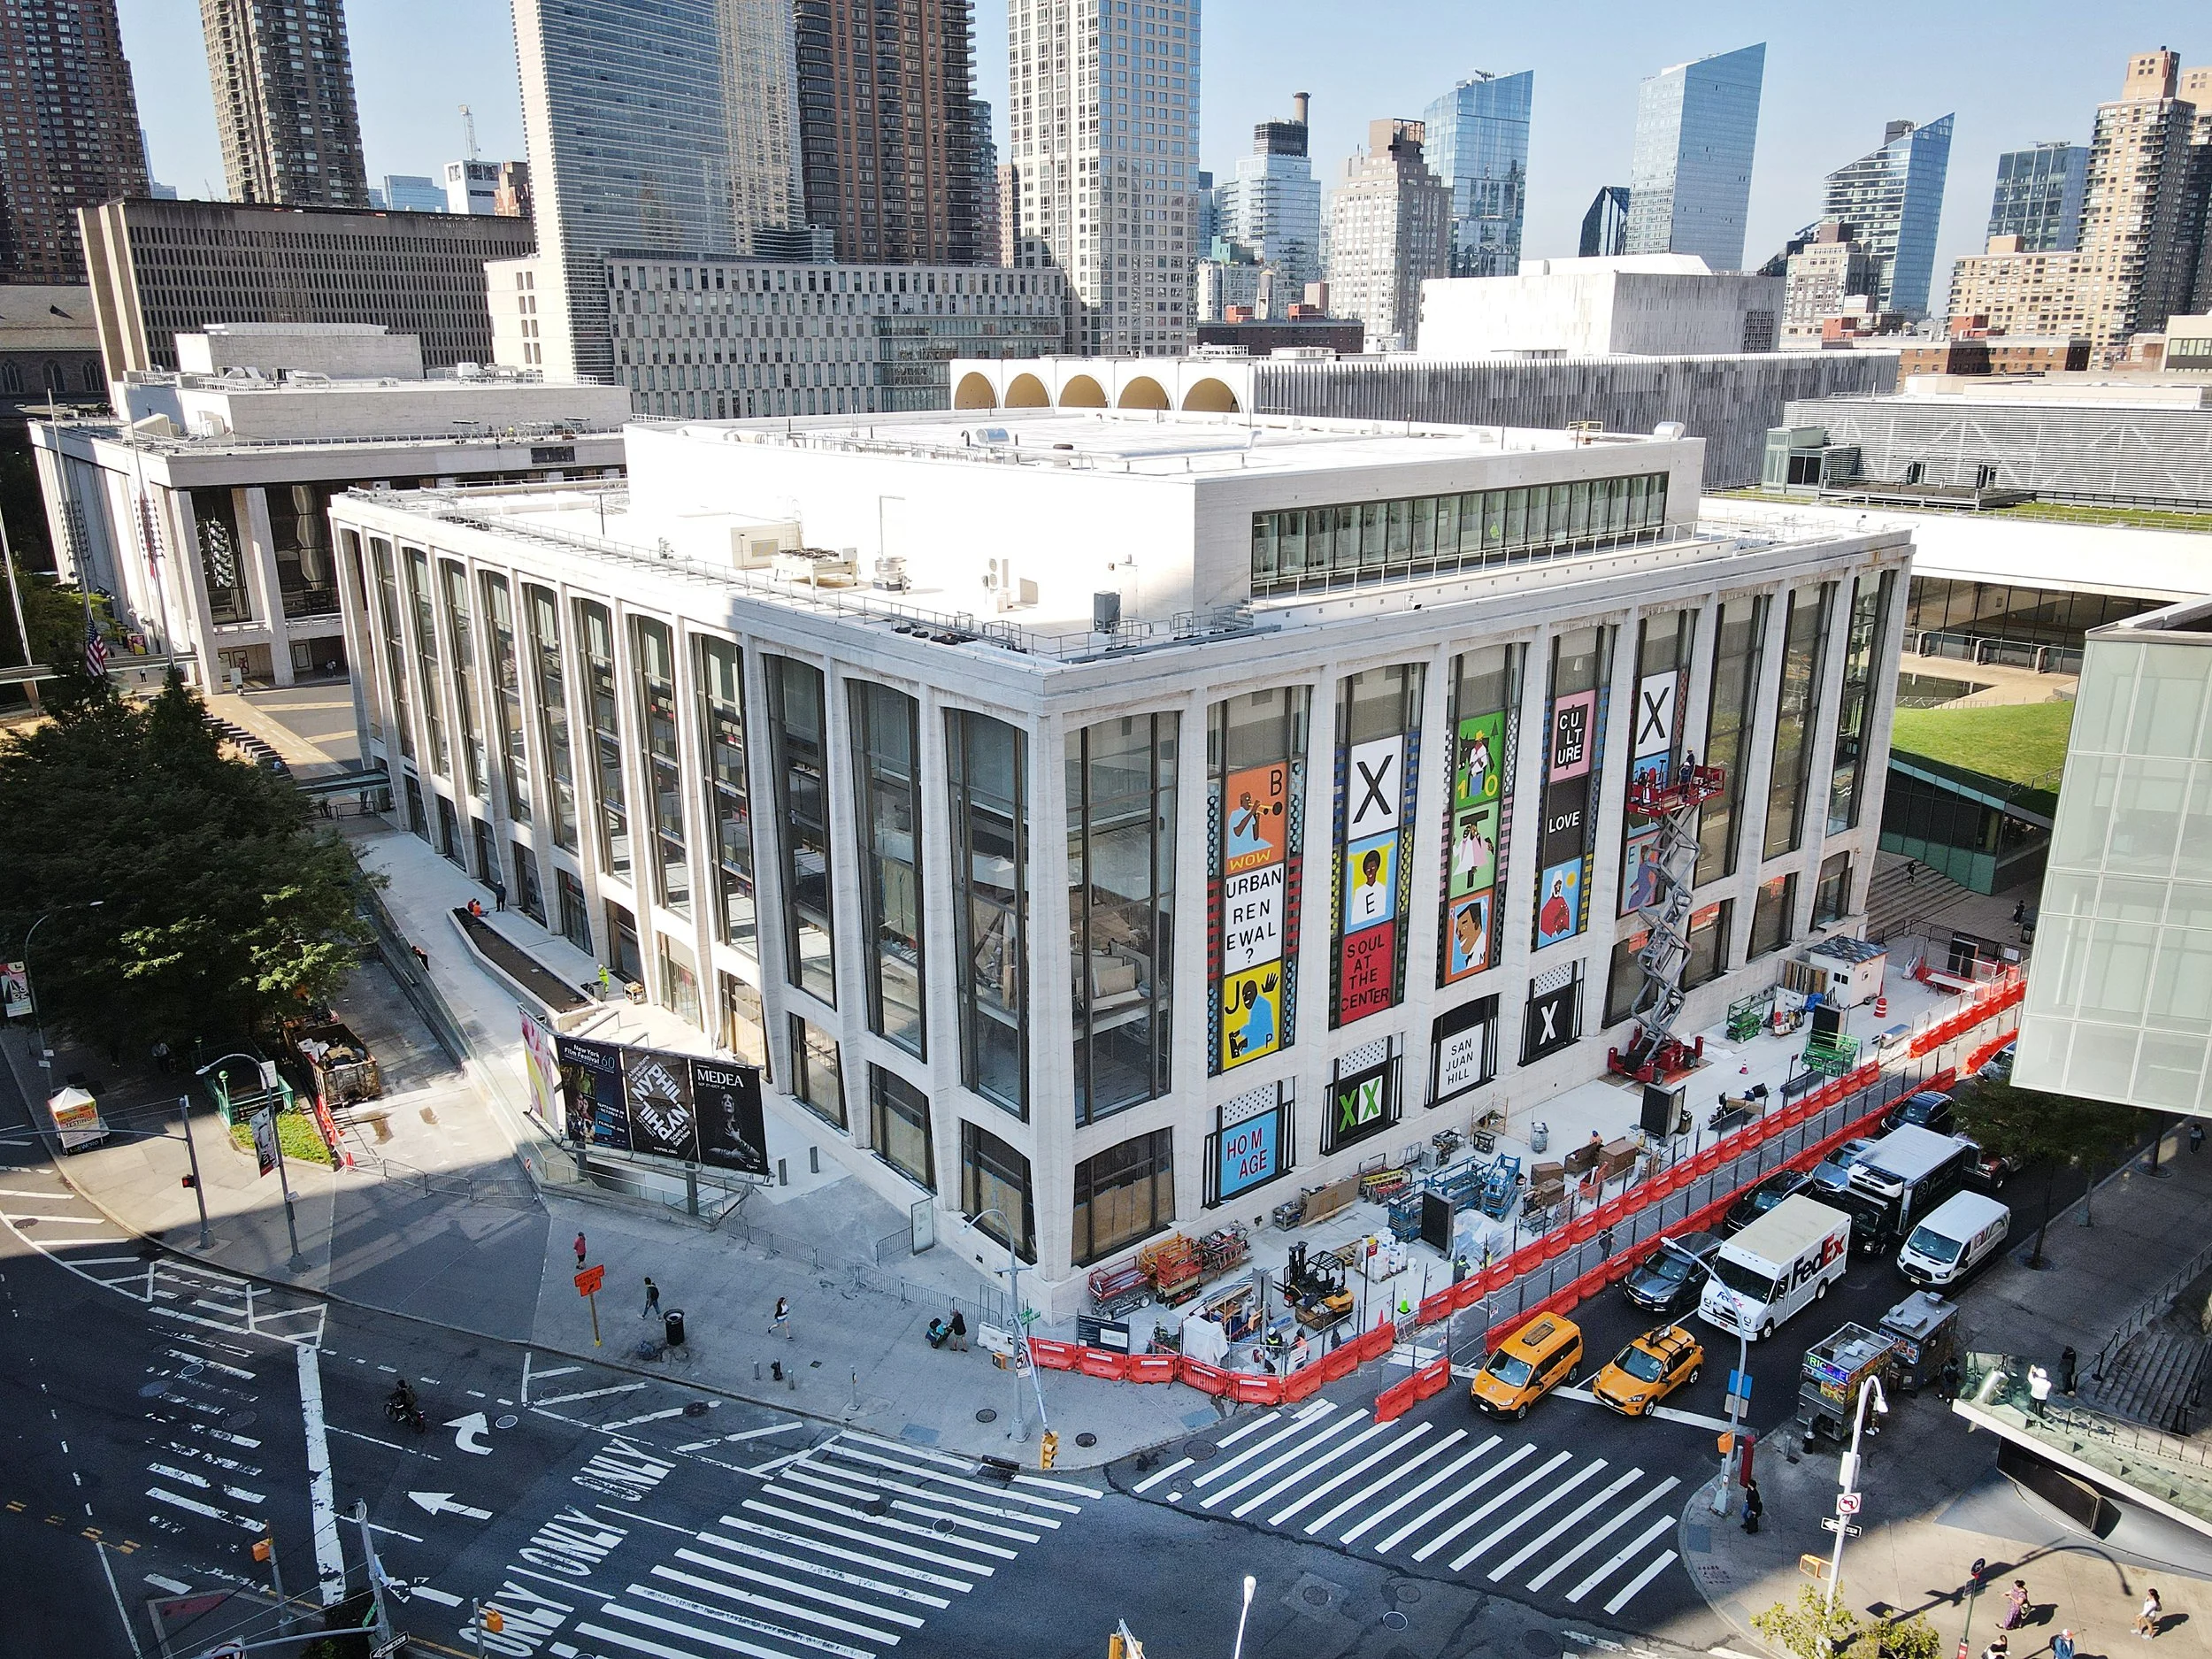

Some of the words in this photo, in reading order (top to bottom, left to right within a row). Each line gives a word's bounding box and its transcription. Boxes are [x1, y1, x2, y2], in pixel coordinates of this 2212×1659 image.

[1638, 687, 1670, 746] X
[1271, 769, 1283, 796] B
[1352, 754, 1394, 825] X
[1548, 811, 1580, 833] LOVE
[1230, 849, 1271, 871] WOW
[1226, 868, 1281, 898] URBAN
[1233, 899, 1270, 925] REN
[1365, 893, 1376, 914] E
[1226, 922, 1276, 951] EWAL
[1347, 934, 1384, 958] SOUL
[1354, 955, 1371, 973] AT
[1349, 968, 1378, 989] THE
[1341, 987, 1389, 1012] CENTER
[1539, 1000, 1559, 1046] X
[565, 1047, 577, 1056] Film
[577, 1052, 600, 1064] Festival
[602, 1055, 615, 1069] 60
[573, 1044, 586, 1053] New
[587, 1048, 600, 1058] York
[1451, 1038, 1472, 1056] SAN
[1446, 1051, 1473, 1071] JUAN
[697, 1069, 744, 1088] MEDEA
[1448, 1068, 1470, 1086] HILL
[1227, 1127, 1263, 1161] HOM
[1239, 1148, 1268, 1179] AGE
[1791, 1233, 1847, 1292] FedEx
[572, 1438, 676, 1502] ONLY
[518, 1504, 628, 1576] ONLY
